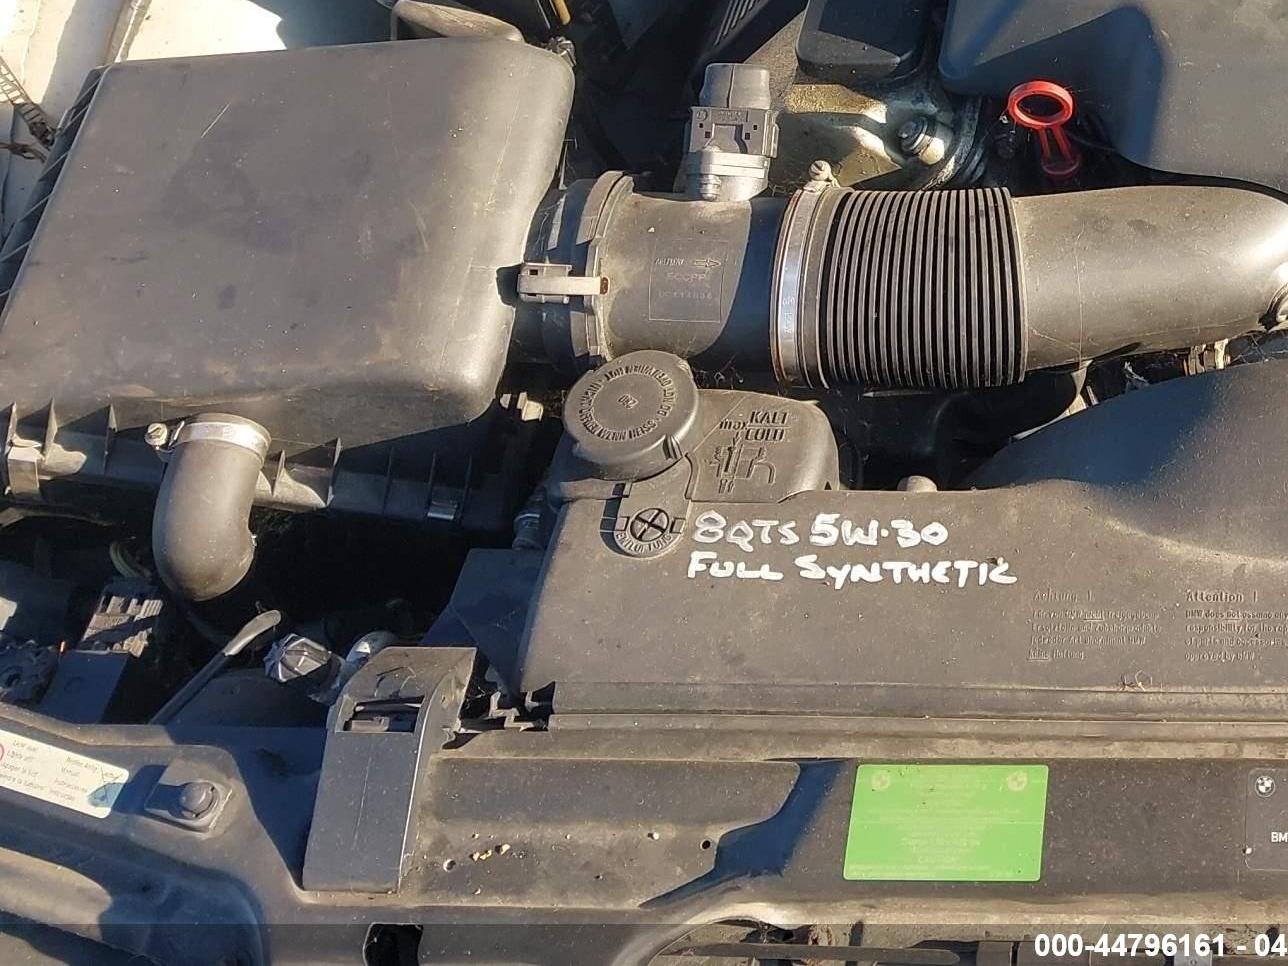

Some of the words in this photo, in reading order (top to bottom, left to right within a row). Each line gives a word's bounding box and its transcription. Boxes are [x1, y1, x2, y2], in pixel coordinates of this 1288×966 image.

[750, 410, 790, 425] KALT
[745, 427, 786, 442] COLD
[687, 551, 784, 581] FULL
[794, 554, 1018, 590] SYNTHETIC
[1186, 590, 1244, 603] Attention
[1226, 610, 1241, 620] not
